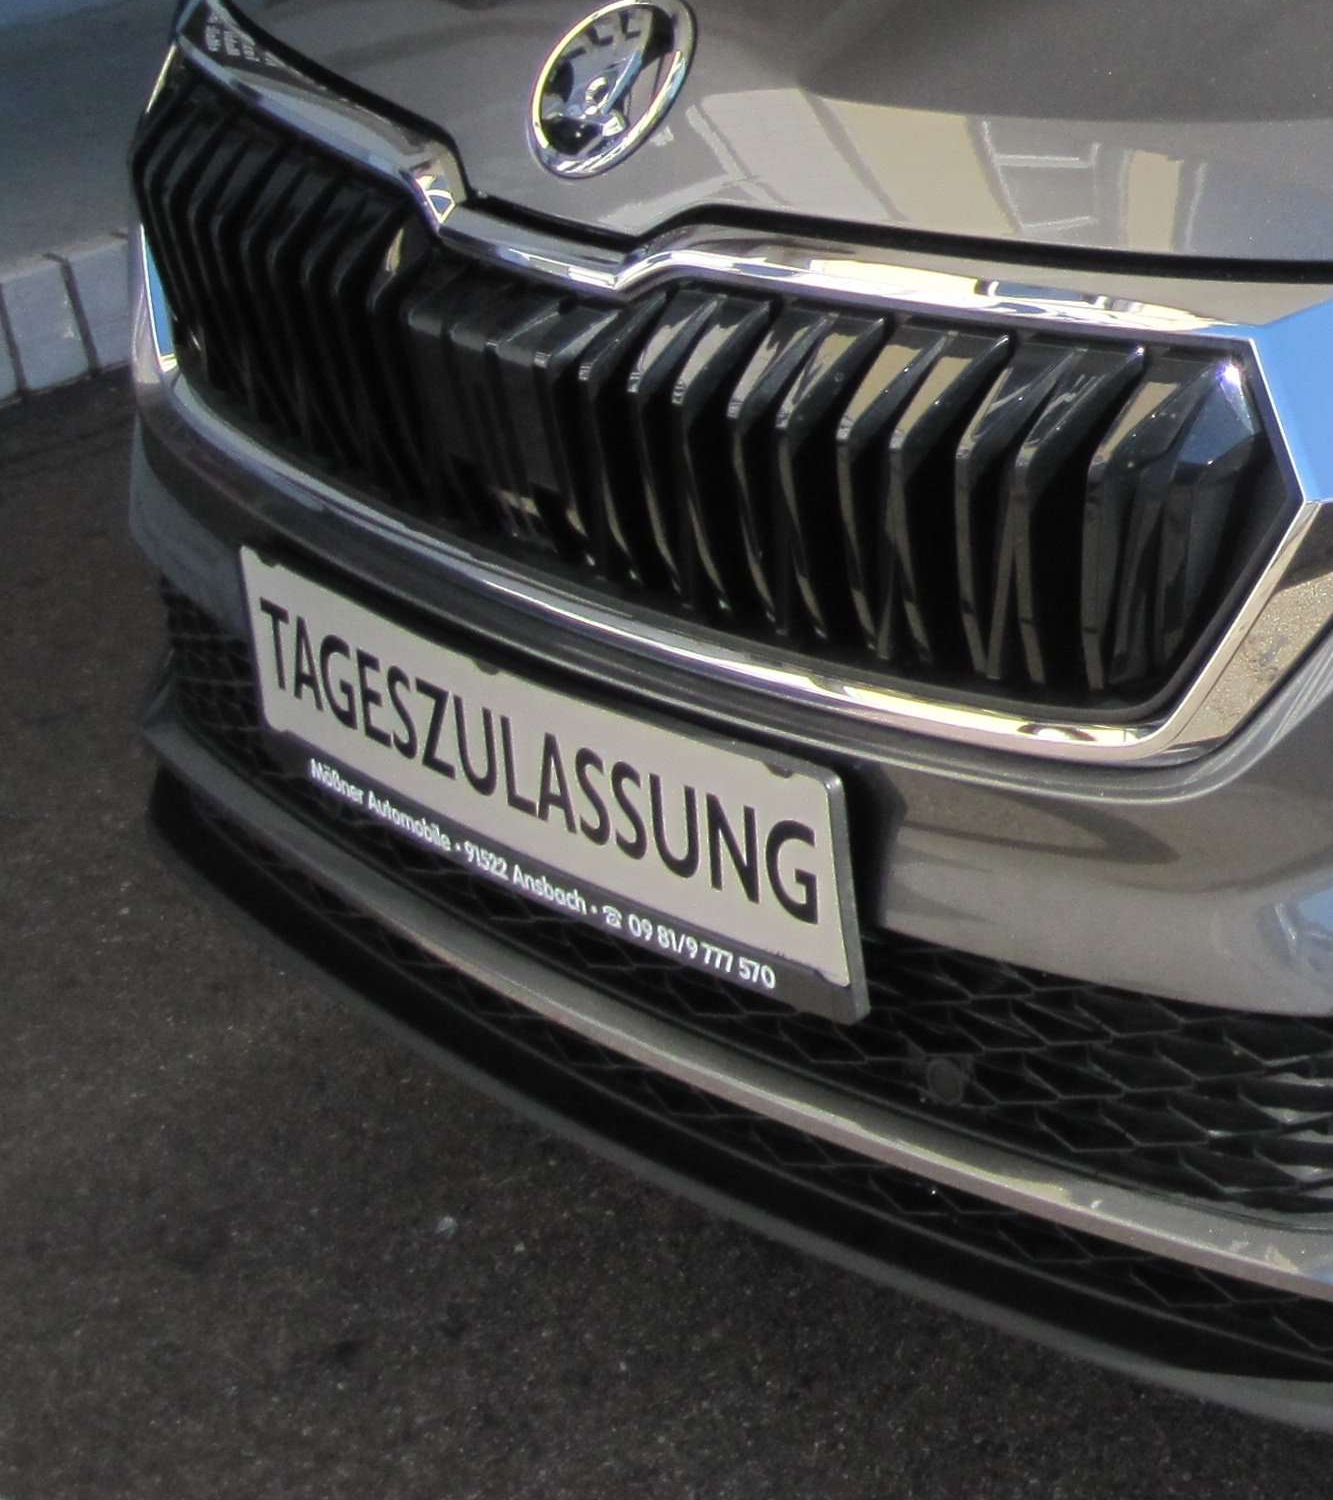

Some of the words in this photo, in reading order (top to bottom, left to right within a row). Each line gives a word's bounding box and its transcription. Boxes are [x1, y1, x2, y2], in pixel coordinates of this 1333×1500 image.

[260, 597, 819, 925] TAGESZULASSUNG
[310, 758, 365, 805] Mößner
[368, 790, 452, 852] Automobile
[464, 841, 509, 881] 91522
[513, 864, 588, 916] Ansbach
[628, 914, 653, 942] 09
[657, 925, 699, 959] 81/9
[700, 942, 734, 973] 777
[739, 956, 776, 990] 570
